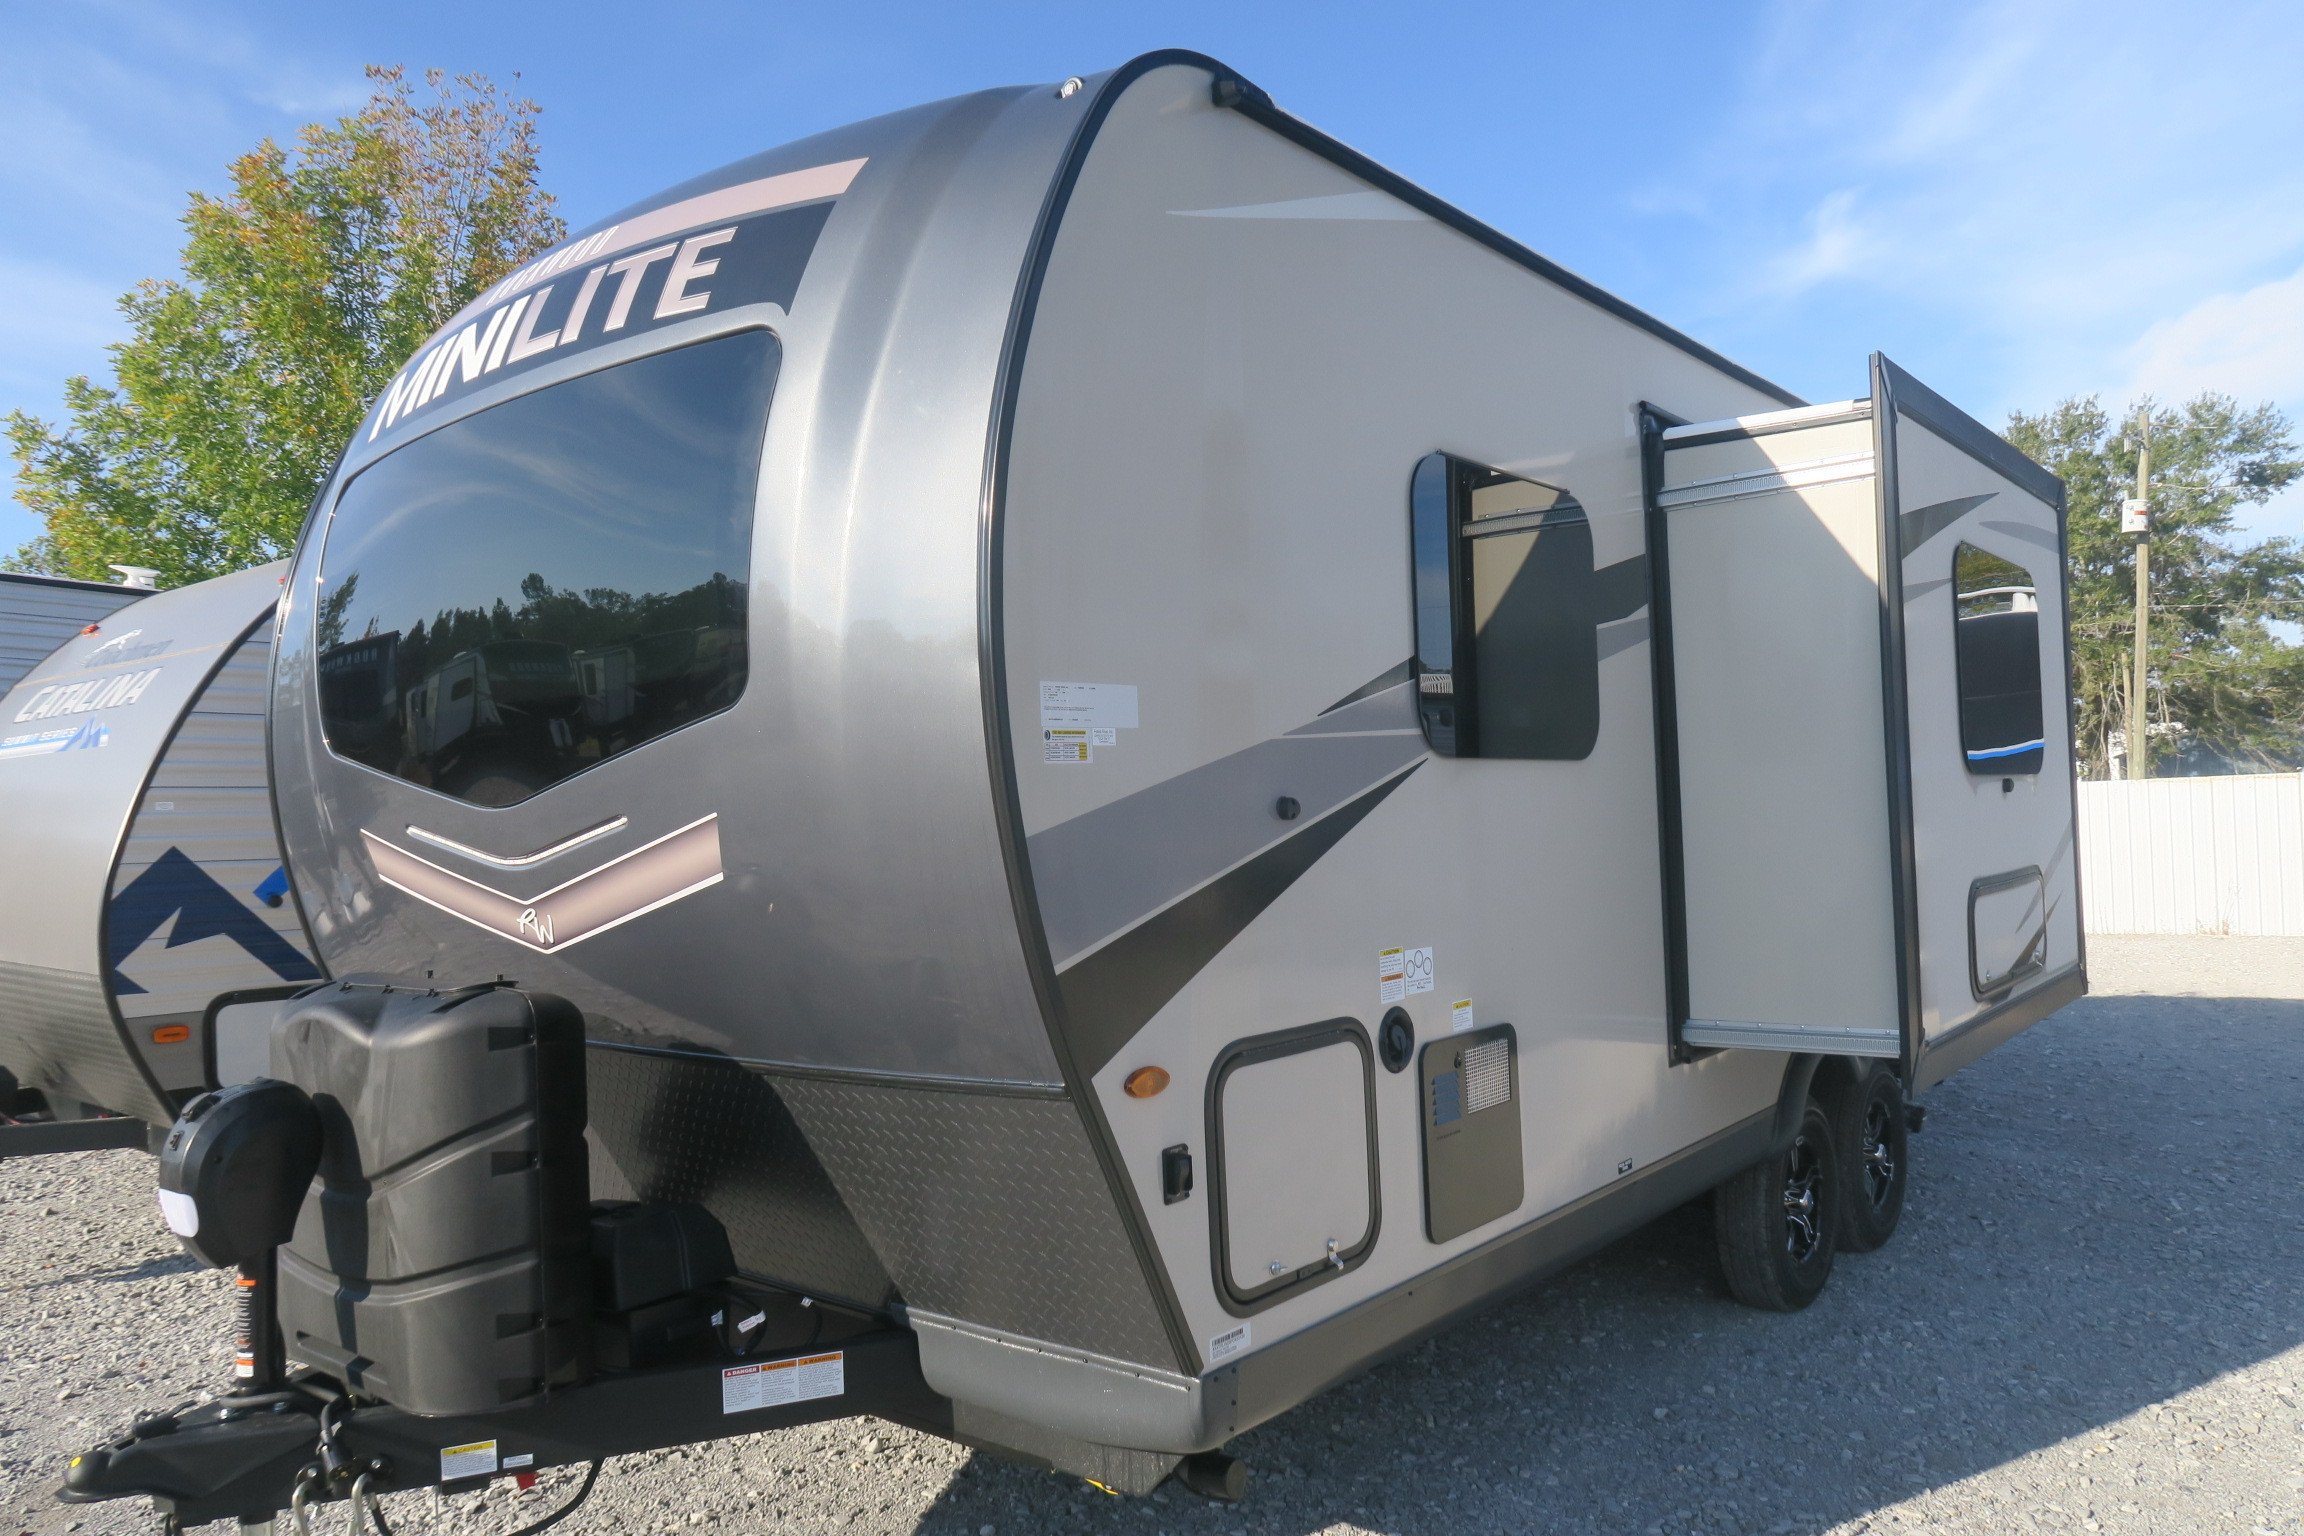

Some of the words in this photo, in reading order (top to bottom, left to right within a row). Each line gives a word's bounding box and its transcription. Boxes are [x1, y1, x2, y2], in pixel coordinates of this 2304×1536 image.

[368, 226, 739, 443] MINILITE
[13, 666, 163, 724] CATALINA
[732, 1366, 758, 1376] DANGER
